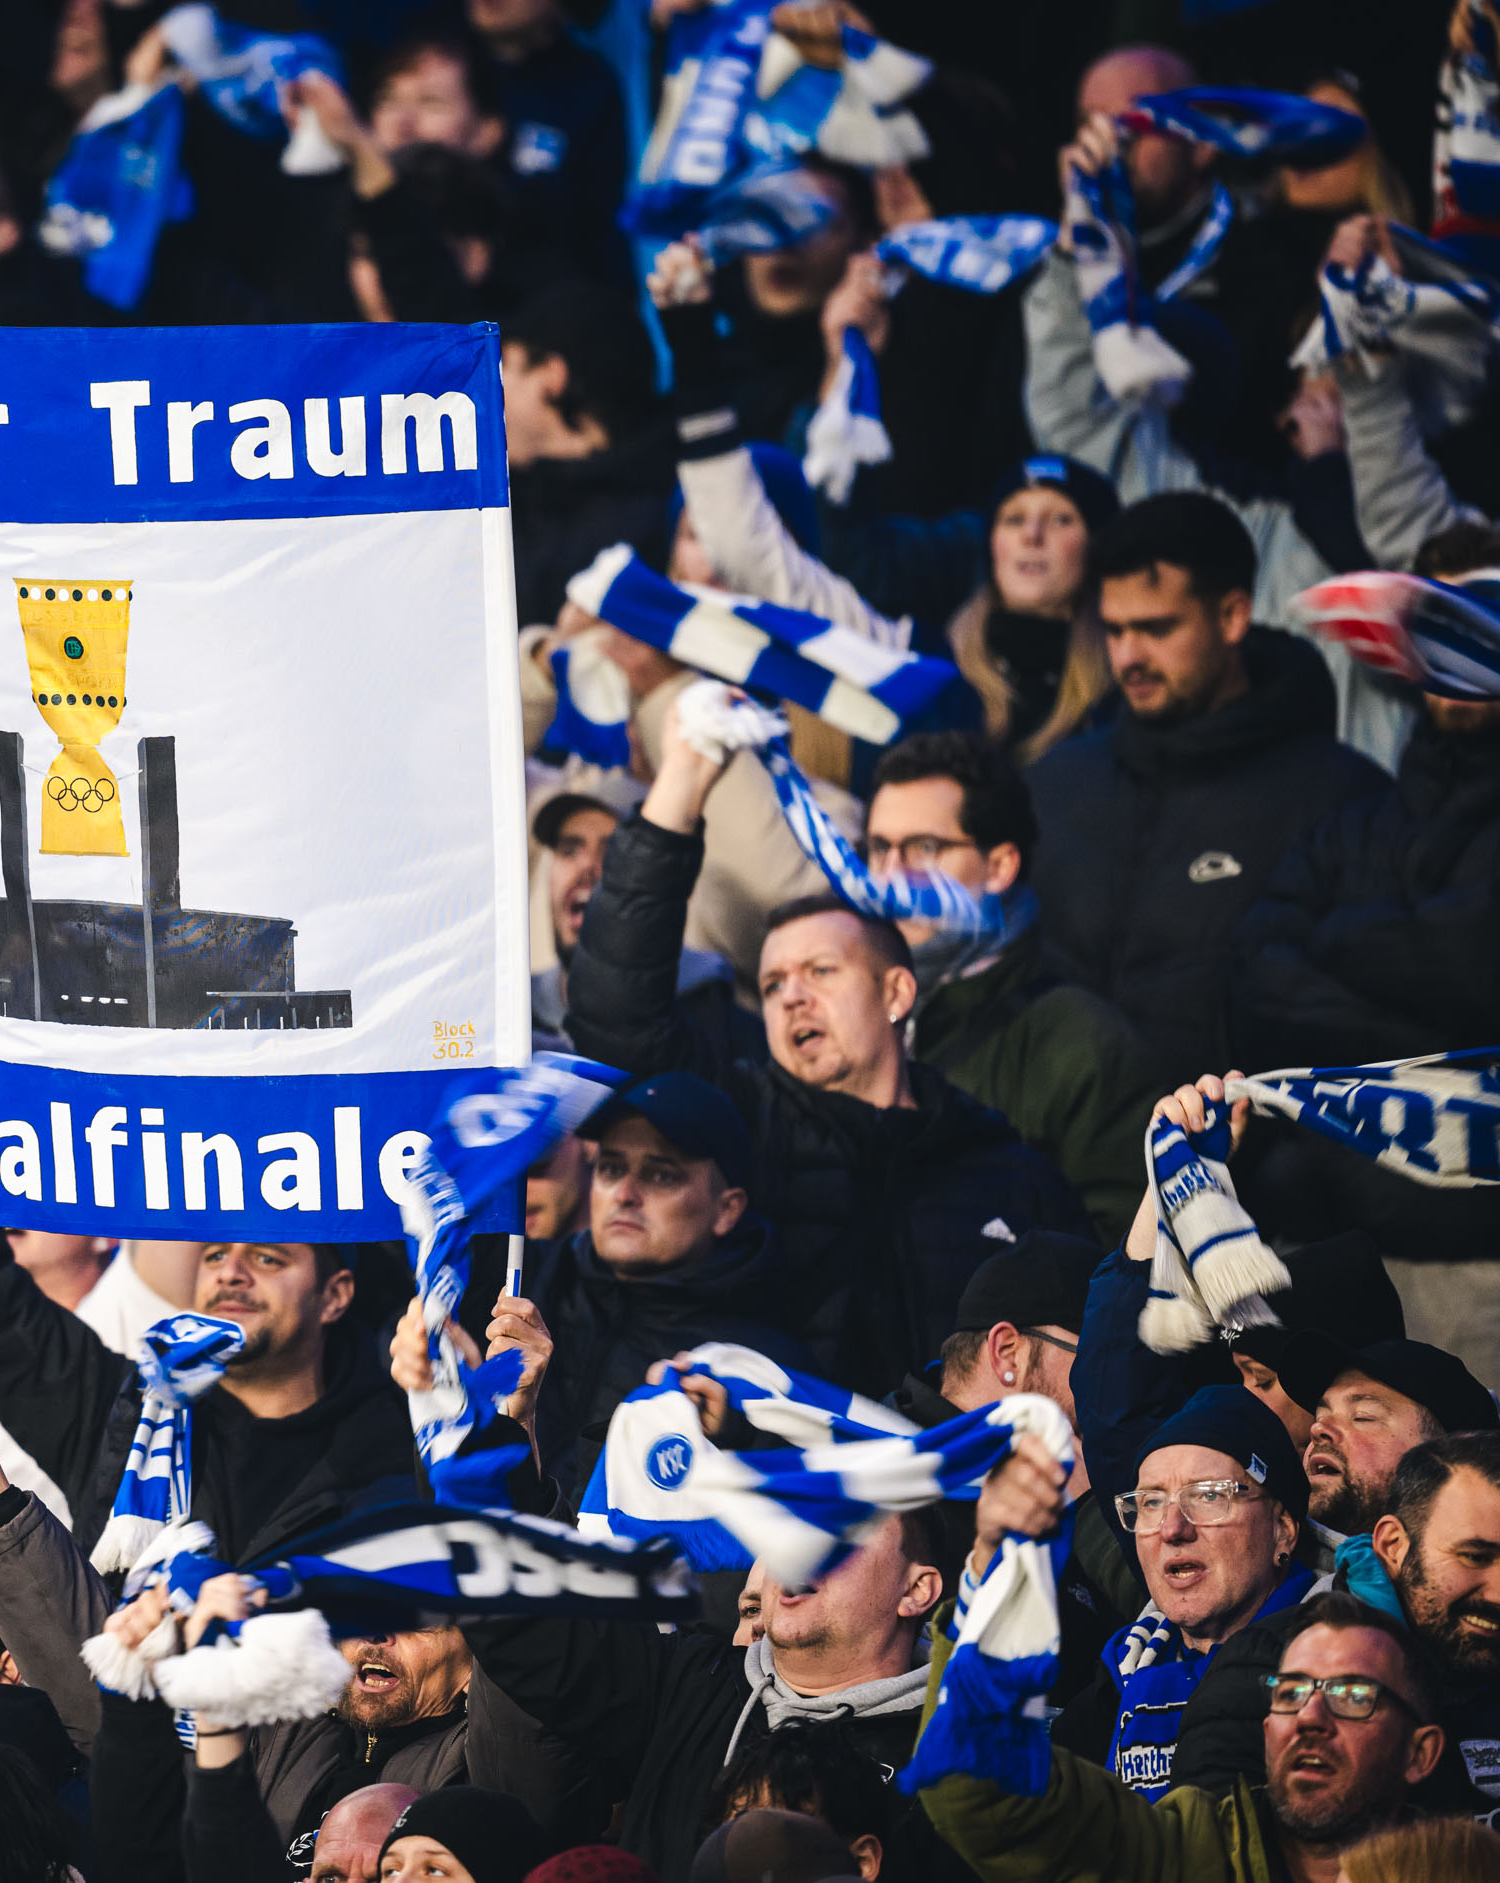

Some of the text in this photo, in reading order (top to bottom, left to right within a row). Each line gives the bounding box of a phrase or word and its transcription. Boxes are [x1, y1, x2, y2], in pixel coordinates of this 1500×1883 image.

[90, 379, 479, 486] Traum
[432, 1020, 476, 1038] Block
[432, 1040, 475, 1060] 30.2
